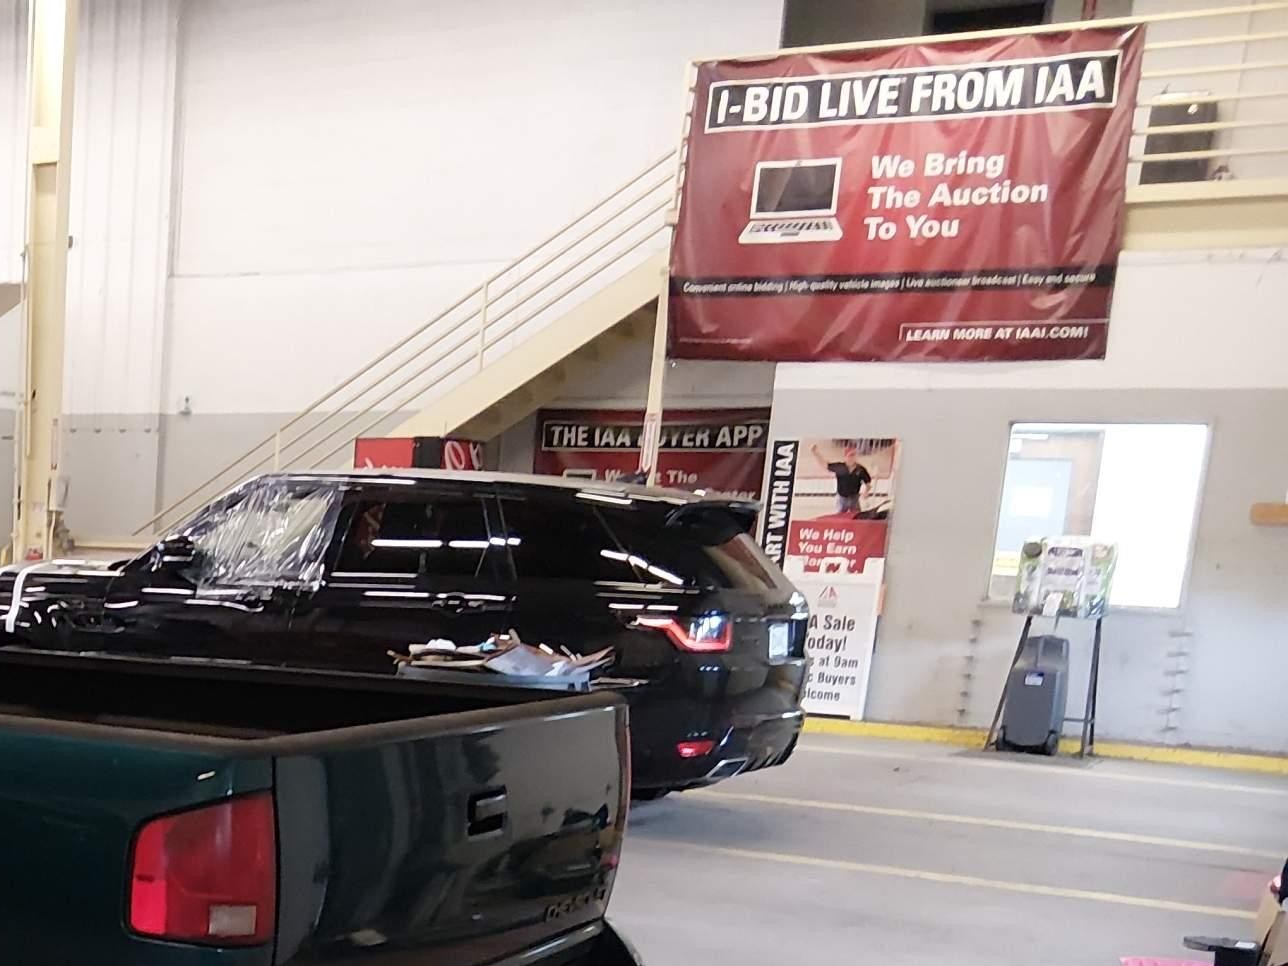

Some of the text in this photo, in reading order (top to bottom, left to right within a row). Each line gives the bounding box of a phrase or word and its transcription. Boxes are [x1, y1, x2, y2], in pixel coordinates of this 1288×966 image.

[716, 59, 1106, 124] I-BID LIVE FROM IAA
[871, 149, 1005, 179] We Bring
[867, 179, 1049, 209] The Auction
[863, 214, 960, 241] To You
[753, 280, 784, 294] bidding
[839, 277, 869, 291] vehicle
[870, 277, 900, 291] images
[905, 277, 924, 289] Live
[906, 327, 951, 342] LEARN
[953, 326, 992, 341] MORE
[994, 326, 1013, 340] AT
[550, 425, 590, 448] THE
[594, 427, 632, 448] IAA
[715, 425, 764, 448] APP
[773, 442, 795, 477] IAA
[767, 480, 791, 530] WITH
[799, 527, 854, 542] We Help
[798, 541, 857, 555] You Earn
[823, 614, 856, 632] Sale
[806, 633, 848, 653] oday!
[818, 656, 830, 668] at
[833, 655, 859, 669] 9am
[817, 671, 857, 686] Buyers
